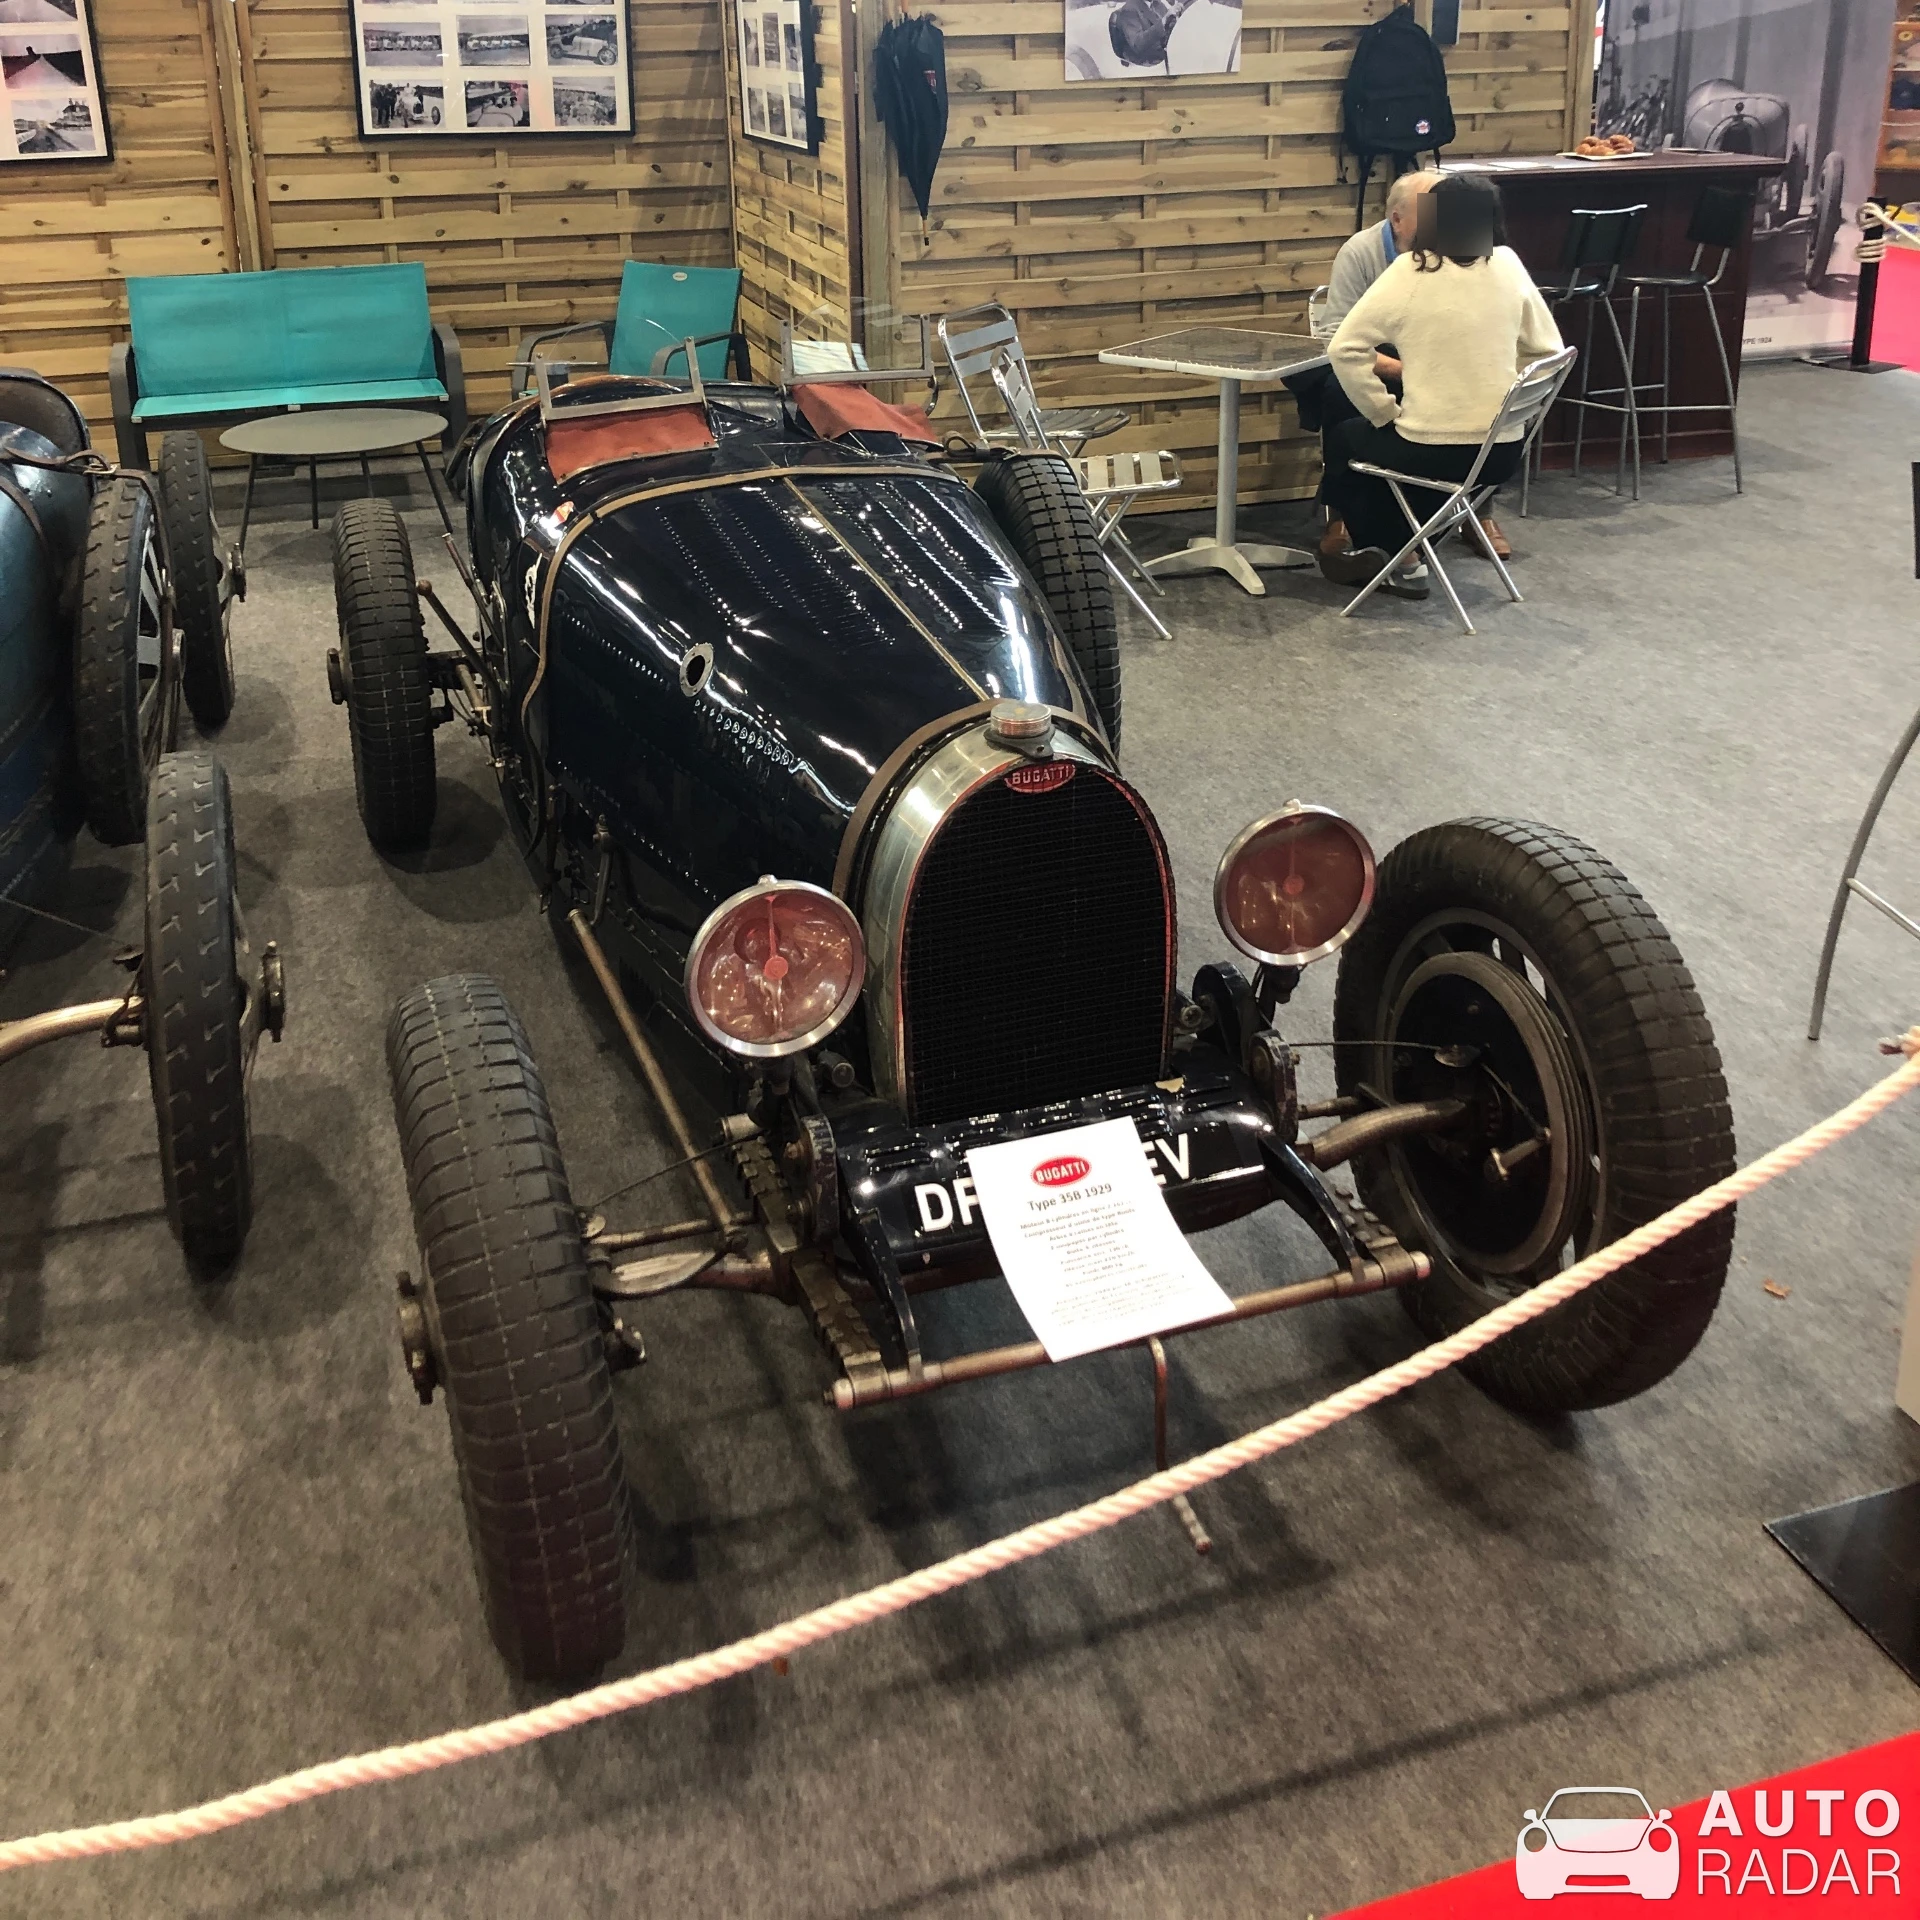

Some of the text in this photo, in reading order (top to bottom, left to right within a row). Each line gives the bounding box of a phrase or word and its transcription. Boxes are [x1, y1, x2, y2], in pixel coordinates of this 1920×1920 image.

[1012, 765, 1069, 785] BUGATTI
[1035, 1160, 1087, 1183] BUGATTI
[1027, 1183, 1113, 1211] Type 35B 1929
